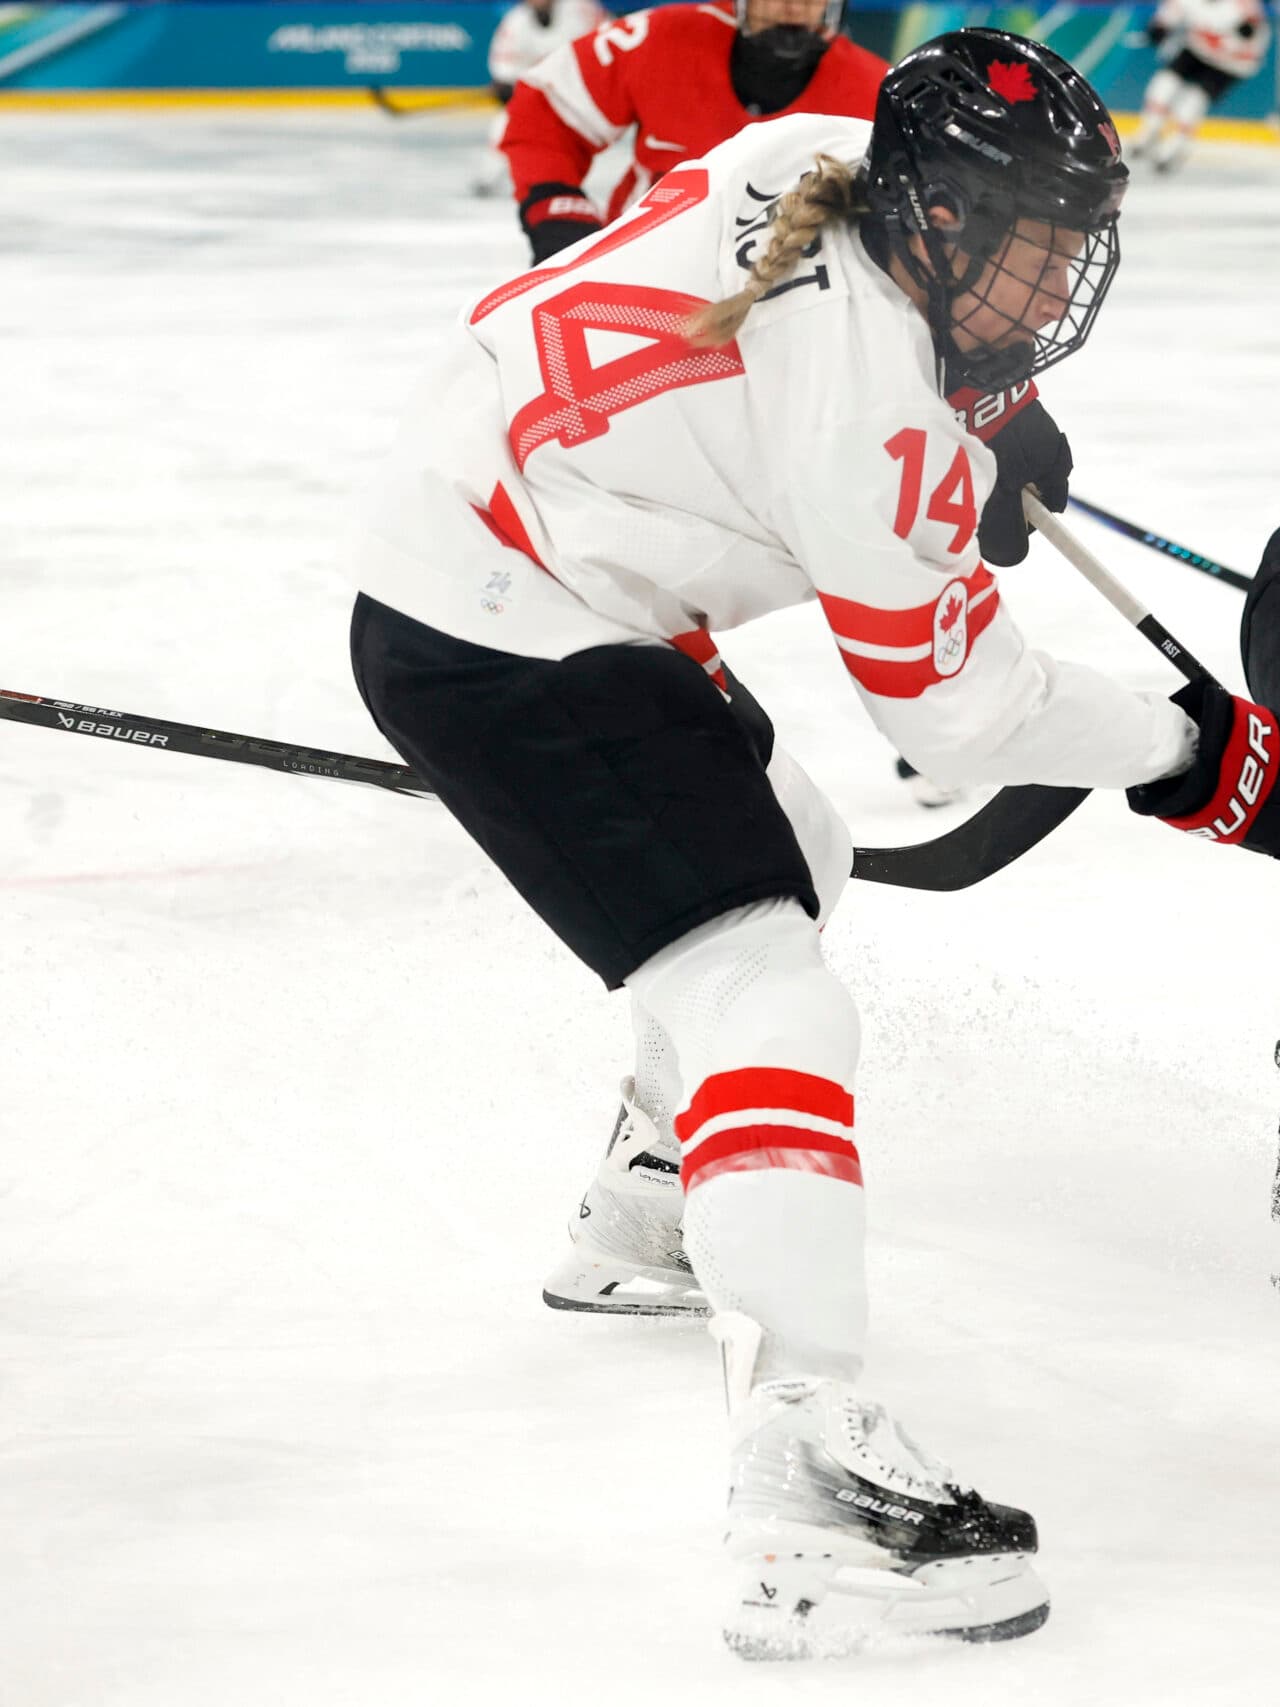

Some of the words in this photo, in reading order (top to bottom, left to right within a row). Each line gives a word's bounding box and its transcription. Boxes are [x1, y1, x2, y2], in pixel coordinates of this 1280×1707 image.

[469, 168, 747, 476] 14
[882, 426, 978, 554] 14
[1160, 638, 1182, 659] FAST
[283, 759, 340, 777] LOADING
